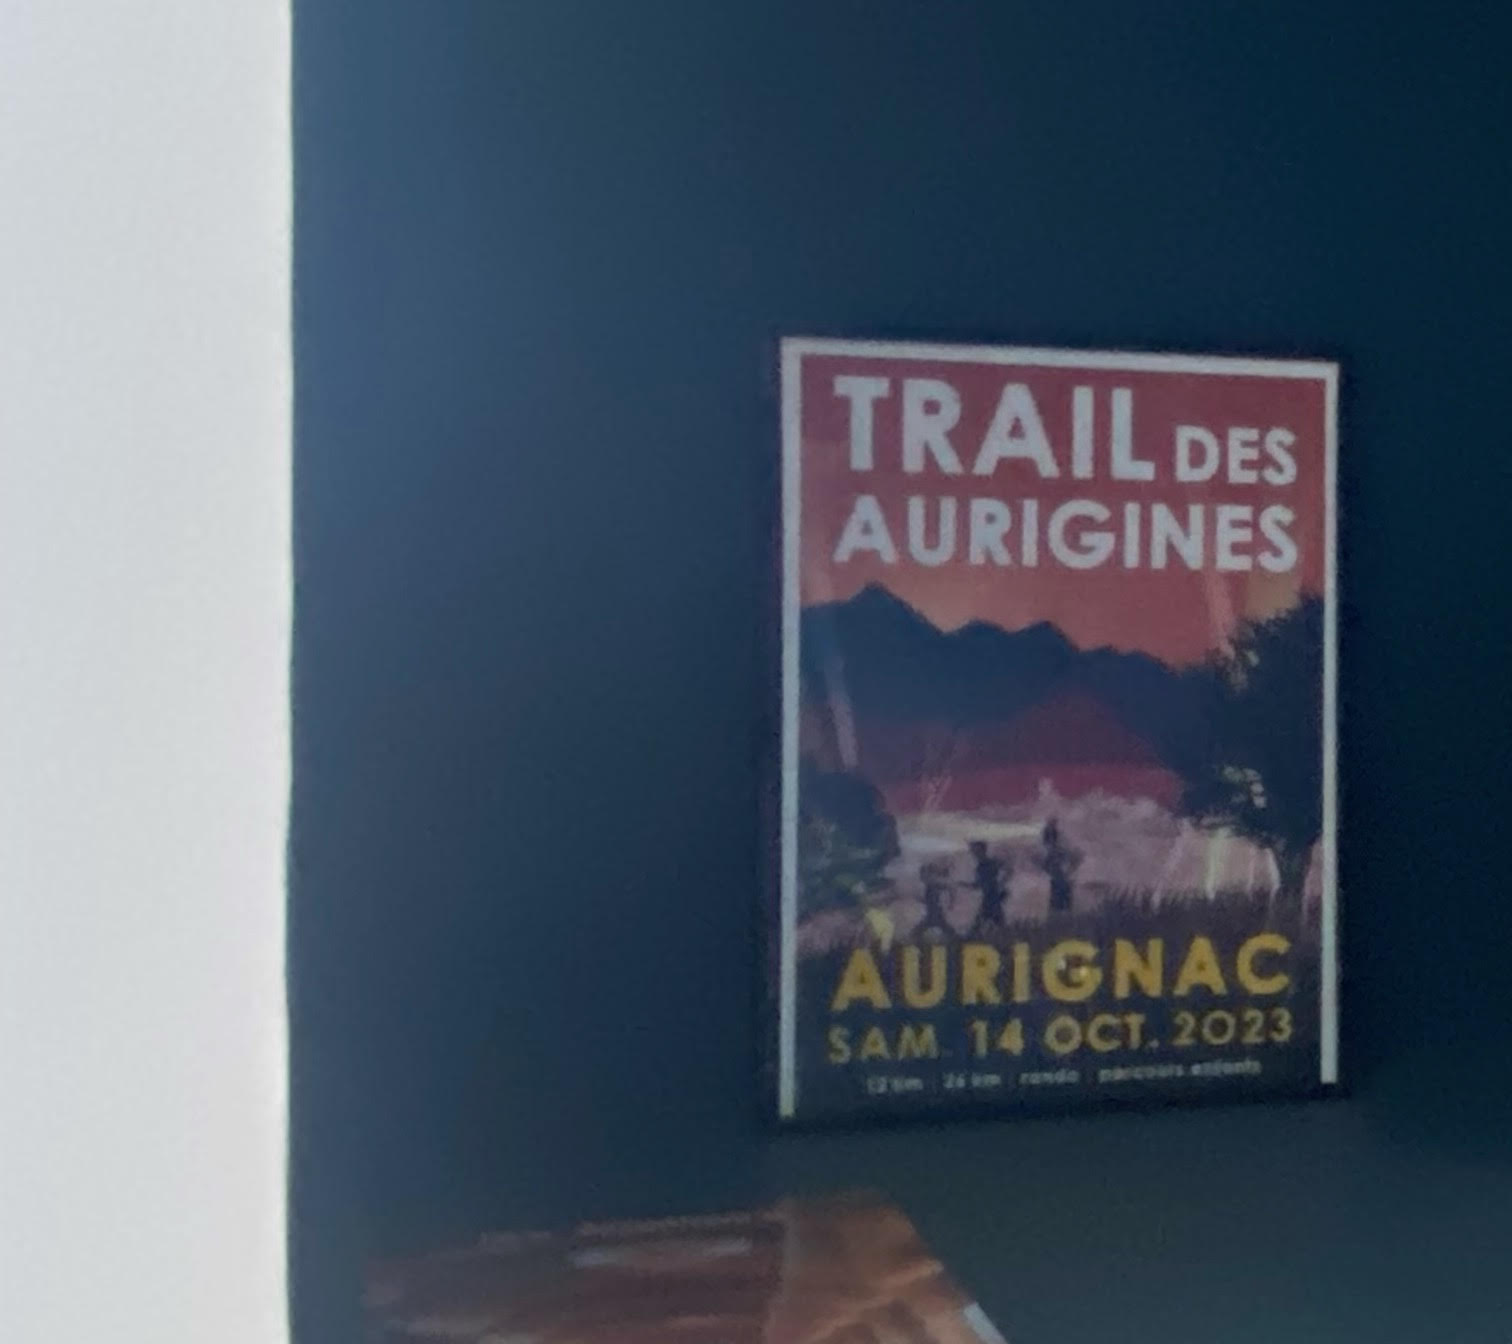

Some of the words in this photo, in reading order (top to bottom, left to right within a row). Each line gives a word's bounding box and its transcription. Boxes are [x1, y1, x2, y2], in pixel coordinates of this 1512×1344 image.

[833, 374, 1155, 482] TRAIL
[1175, 424, 1298, 486] DES
[833, 494, 1299, 574] AURIGINES
[831, 931, 1292, 1011] AURIGNAC
[971, 1017, 1025, 1057] 14
[1044, 1013, 1159, 1053] OCT.
[1171, 1006, 1295, 1047] 2023
